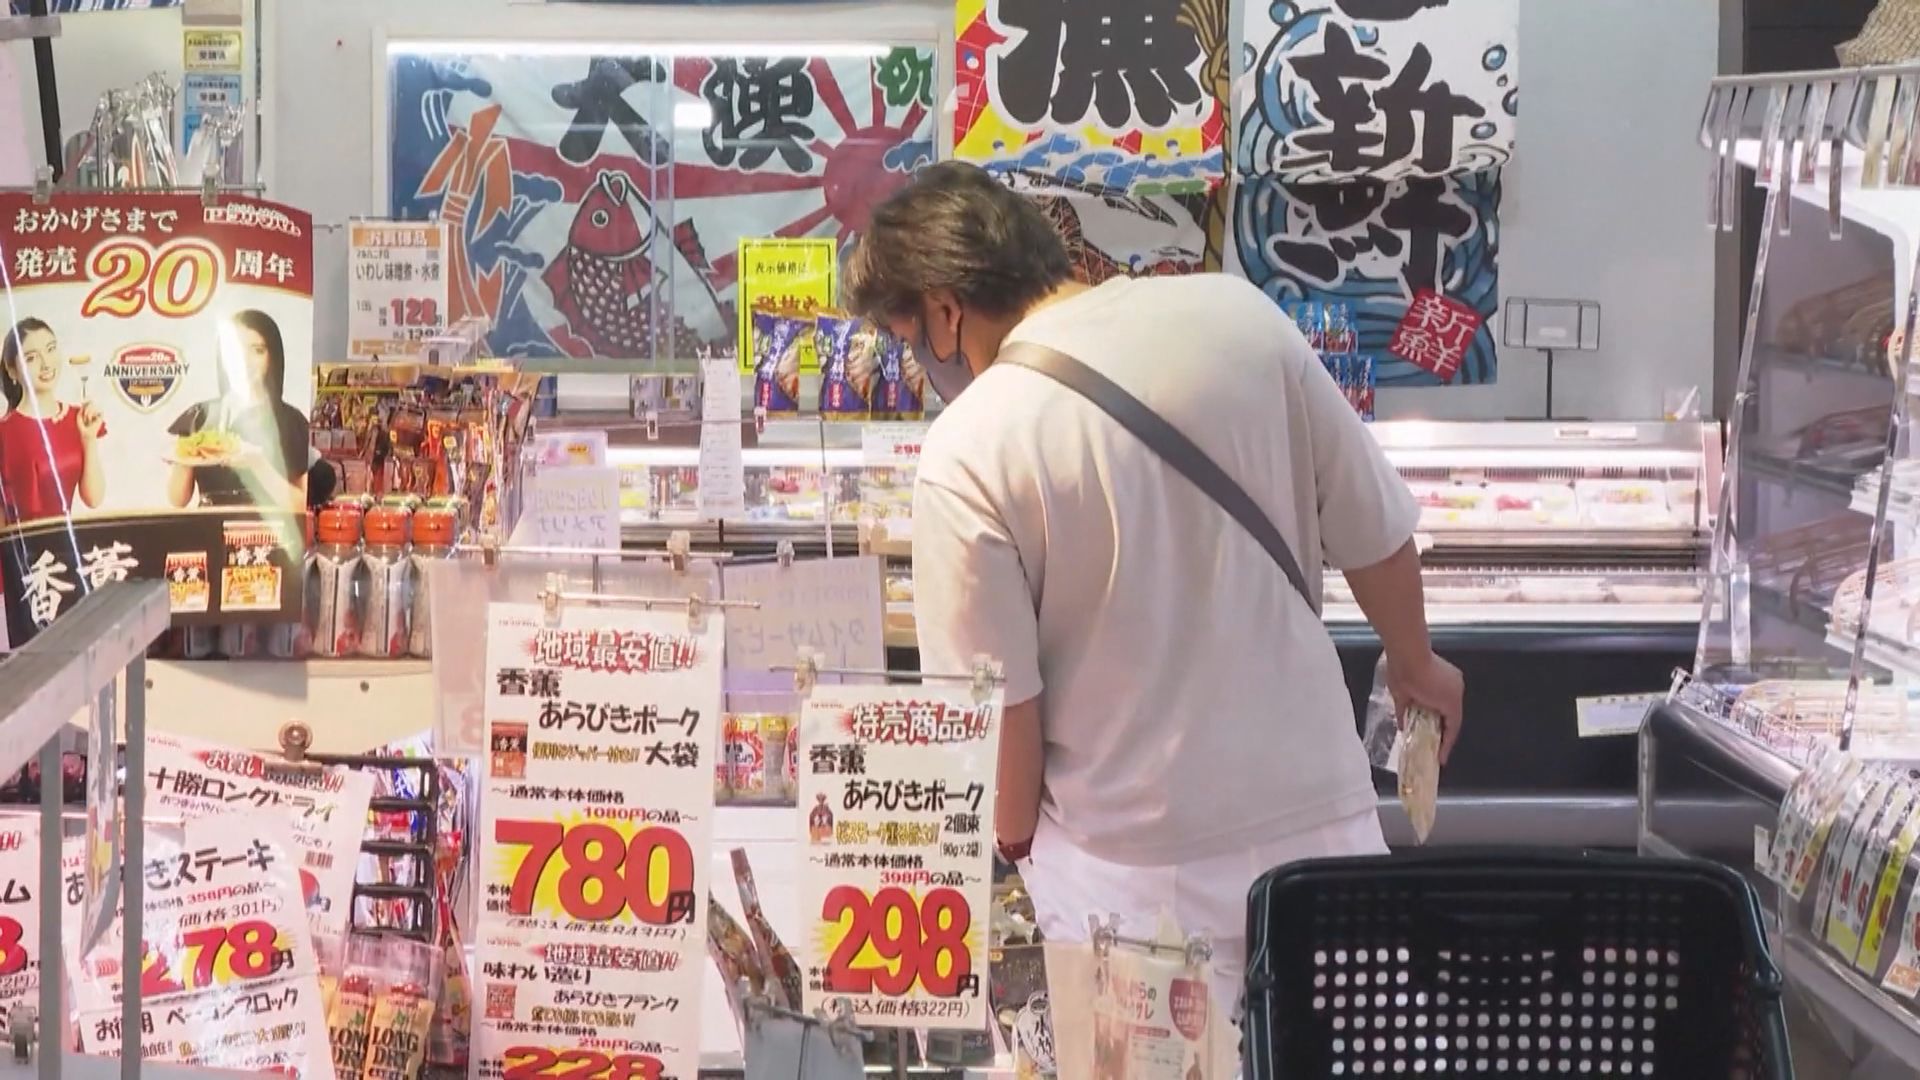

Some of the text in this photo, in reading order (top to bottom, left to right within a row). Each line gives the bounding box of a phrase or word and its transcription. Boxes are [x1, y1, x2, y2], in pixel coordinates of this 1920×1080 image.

[14, 207, 178, 233] おかげさまで
[15, 238, 295, 319] 発売 20 周年
[103, 363, 190, 378] ANNIVERSARY
[538, 700, 700, 736] あらびきポーク
[851, 699, 993, 745] 特売商品!!
[644, 741, 699, 768] 大袋
[842, 778, 984, 812] あらびきポーク
[553, 989, 680, 1012] あらびきフランク
[373, 1026, 419, 1053] LONG
